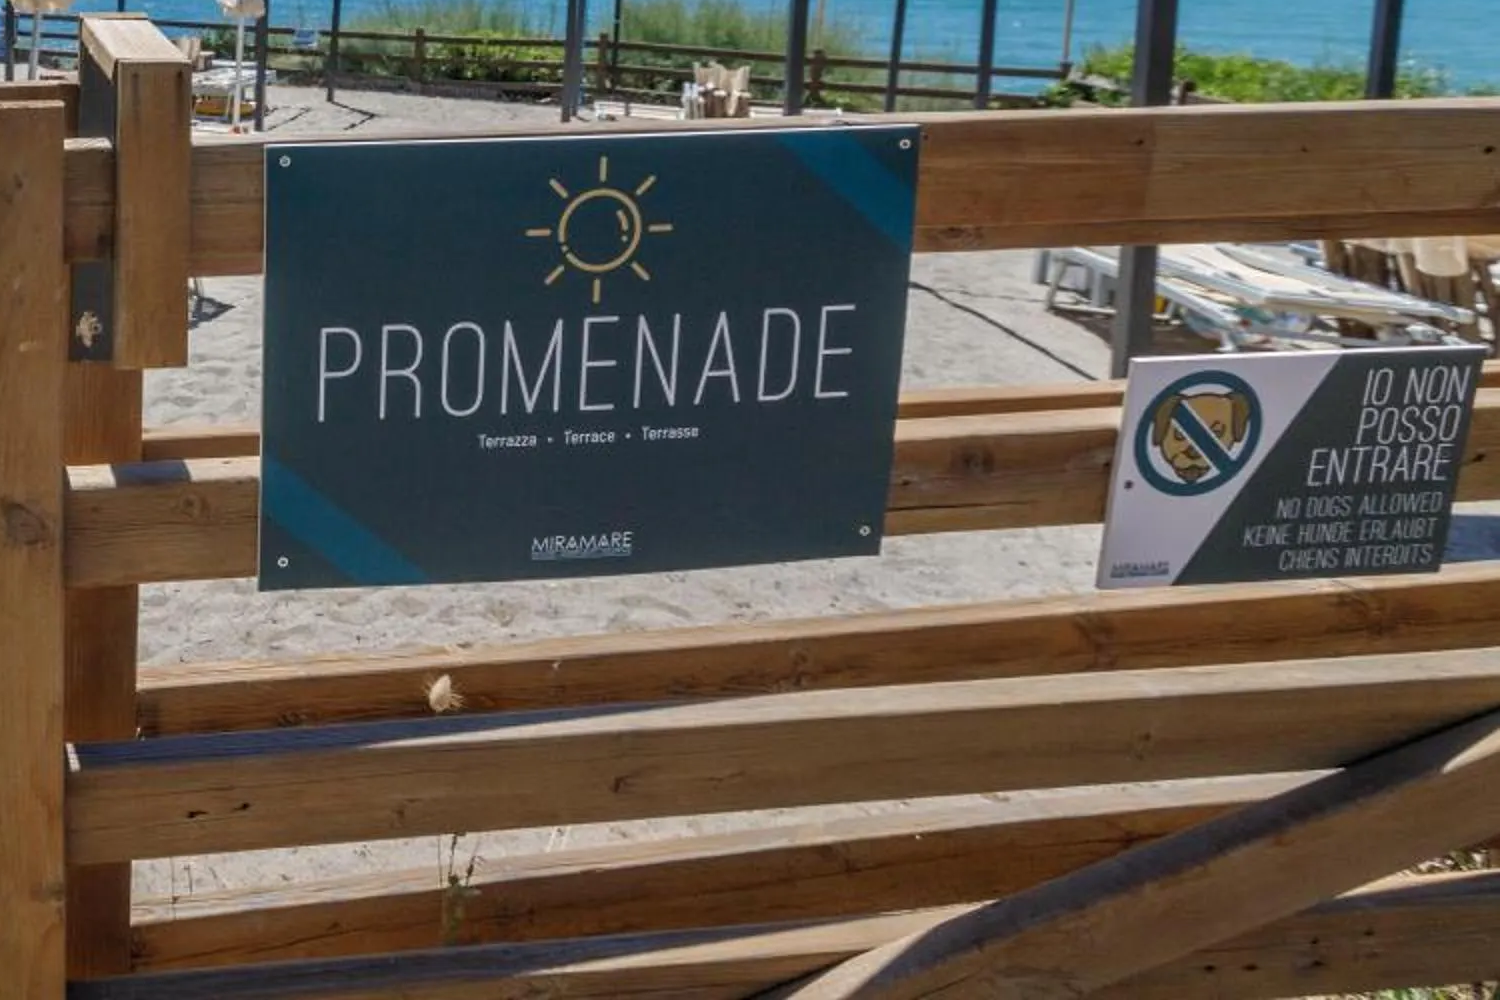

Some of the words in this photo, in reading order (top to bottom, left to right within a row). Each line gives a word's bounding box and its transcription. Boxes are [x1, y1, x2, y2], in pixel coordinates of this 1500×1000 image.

[317, 304, 857, 422] PROMENADE
[1362, 367, 1393, 407] IO
[1402, 364, 1471, 405] NON
[477, 433, 537, 449] Terrazza
[563, 429, 616, 445] Terrace
[641, 425, 700, 441] Terrasse
[1355, 404, 1462, 446] POSSO
[1306, 442, 1455, 488] ENTRARE
[1276, 498, 1302, 519] NO
[1305, 495, 1352, 519] DOGS
[1357, 490, 1444, 516] ALLOWED
[531, 531, 634, 554] MIRAMARE
[1242, 523, 1290, 547] KEINE
[1298, 520, 1352, 546] HUNDE
[1358, 516, 1439, 543] ERLAUBT
[1278, 547, 1340, 572] CHIENS
[1342, 543, 1434, 569] INTERDITS
